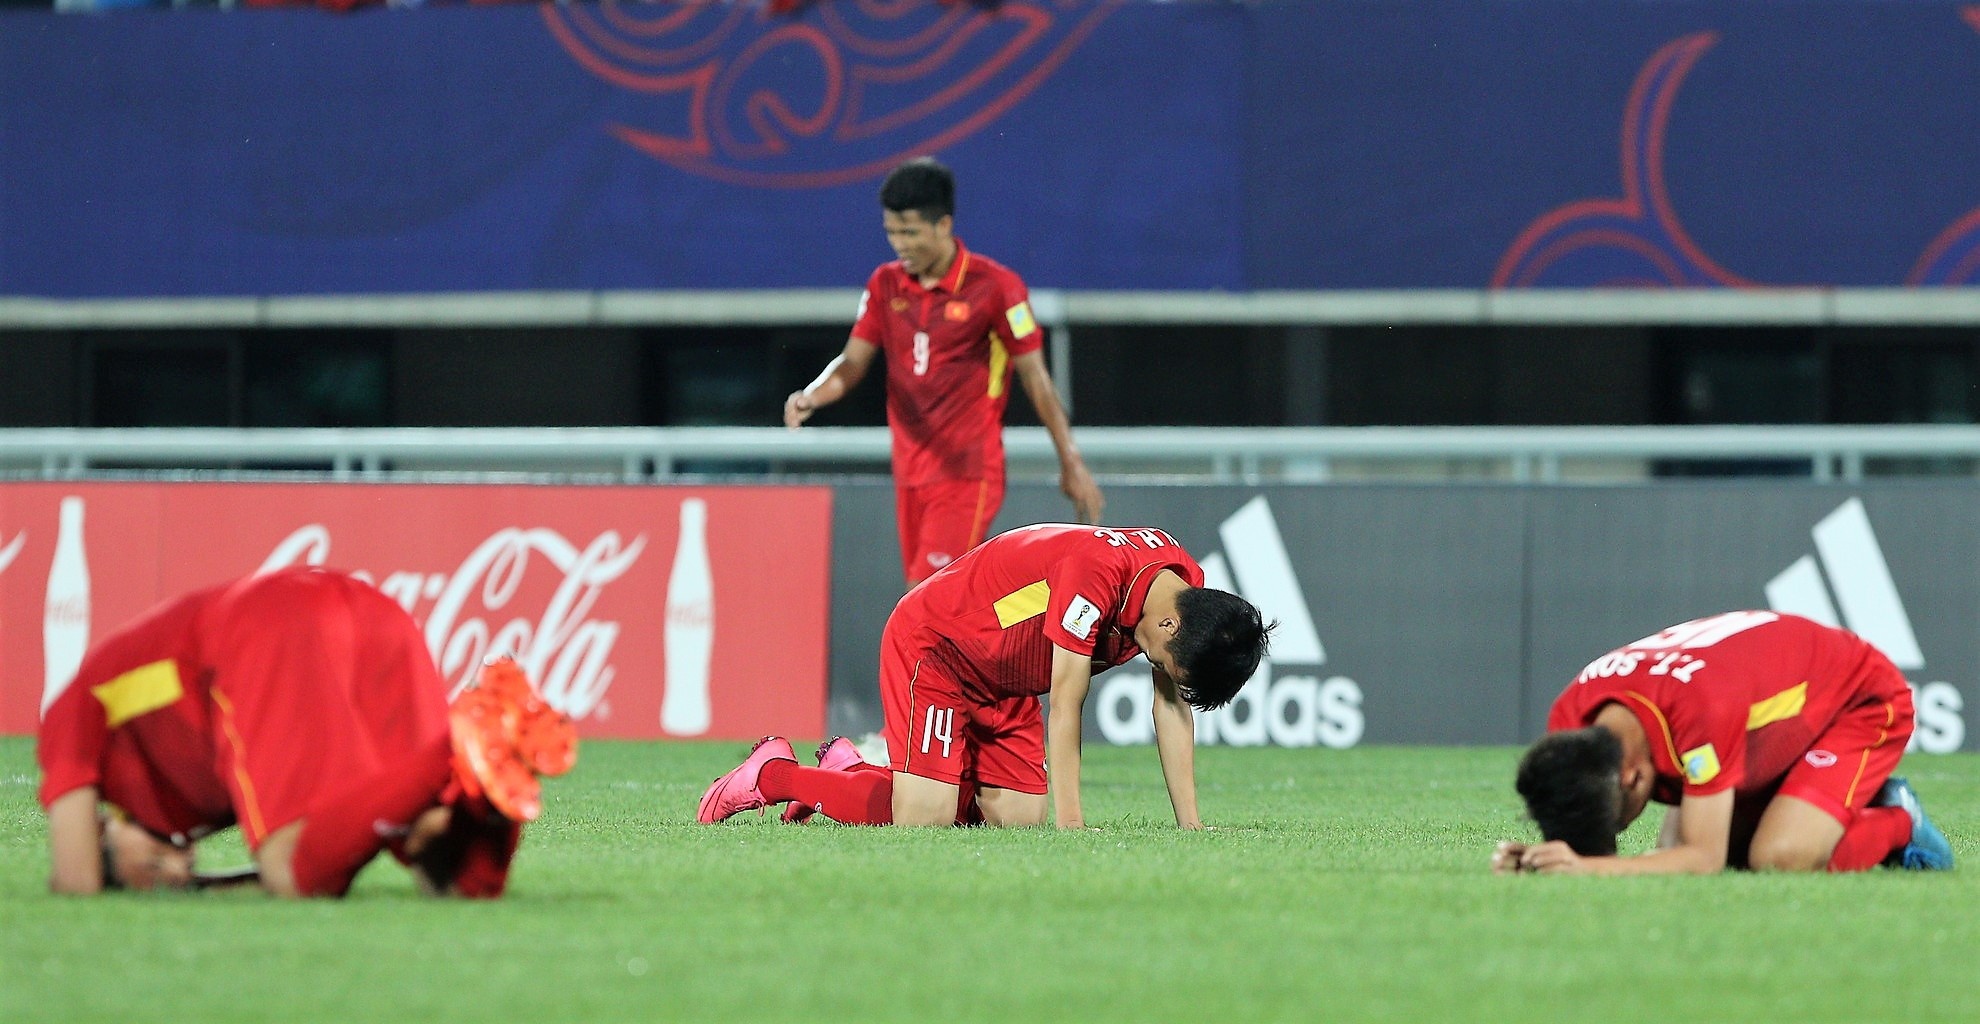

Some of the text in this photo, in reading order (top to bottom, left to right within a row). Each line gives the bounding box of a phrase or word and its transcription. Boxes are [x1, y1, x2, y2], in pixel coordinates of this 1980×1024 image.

[913, 331, 931, 376] 9
[920, 704, 954, 758] 14
[1096, 660, 1365, 749] adas
